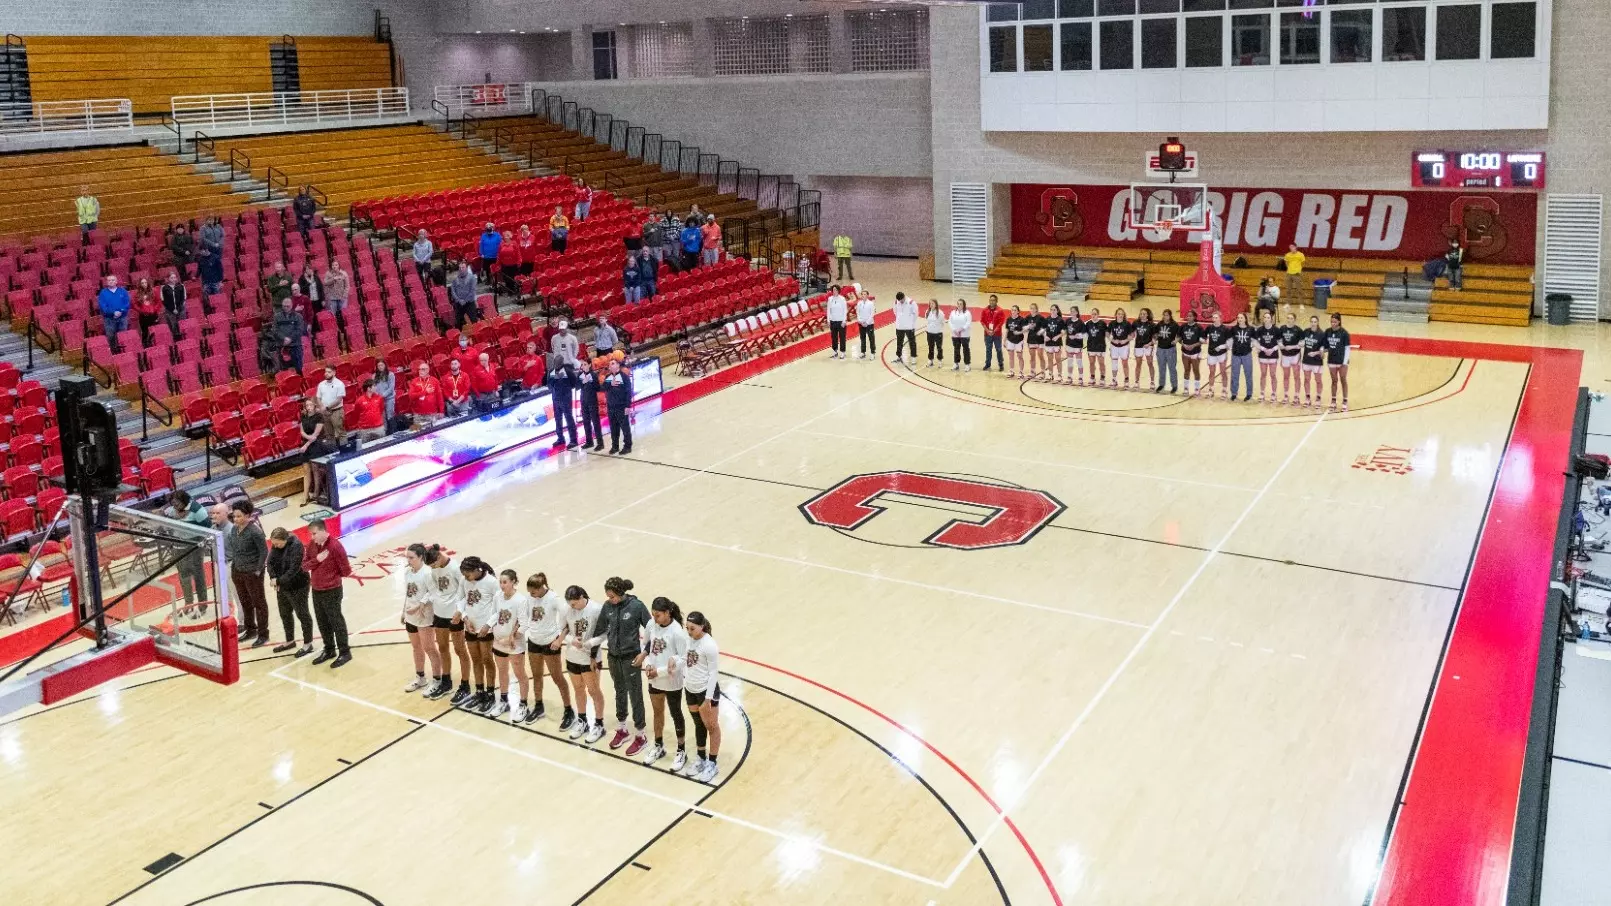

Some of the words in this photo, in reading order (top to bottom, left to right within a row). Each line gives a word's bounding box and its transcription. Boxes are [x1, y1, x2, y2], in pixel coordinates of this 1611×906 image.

[1461, 153, 1501, 169] 10:00
[1433, 163, 1444, 178] 0
[1525, 163, 1537, 179] 0
[1107, 188, 1179, 243] GO
[1295, 193, 1409, 251] RED
